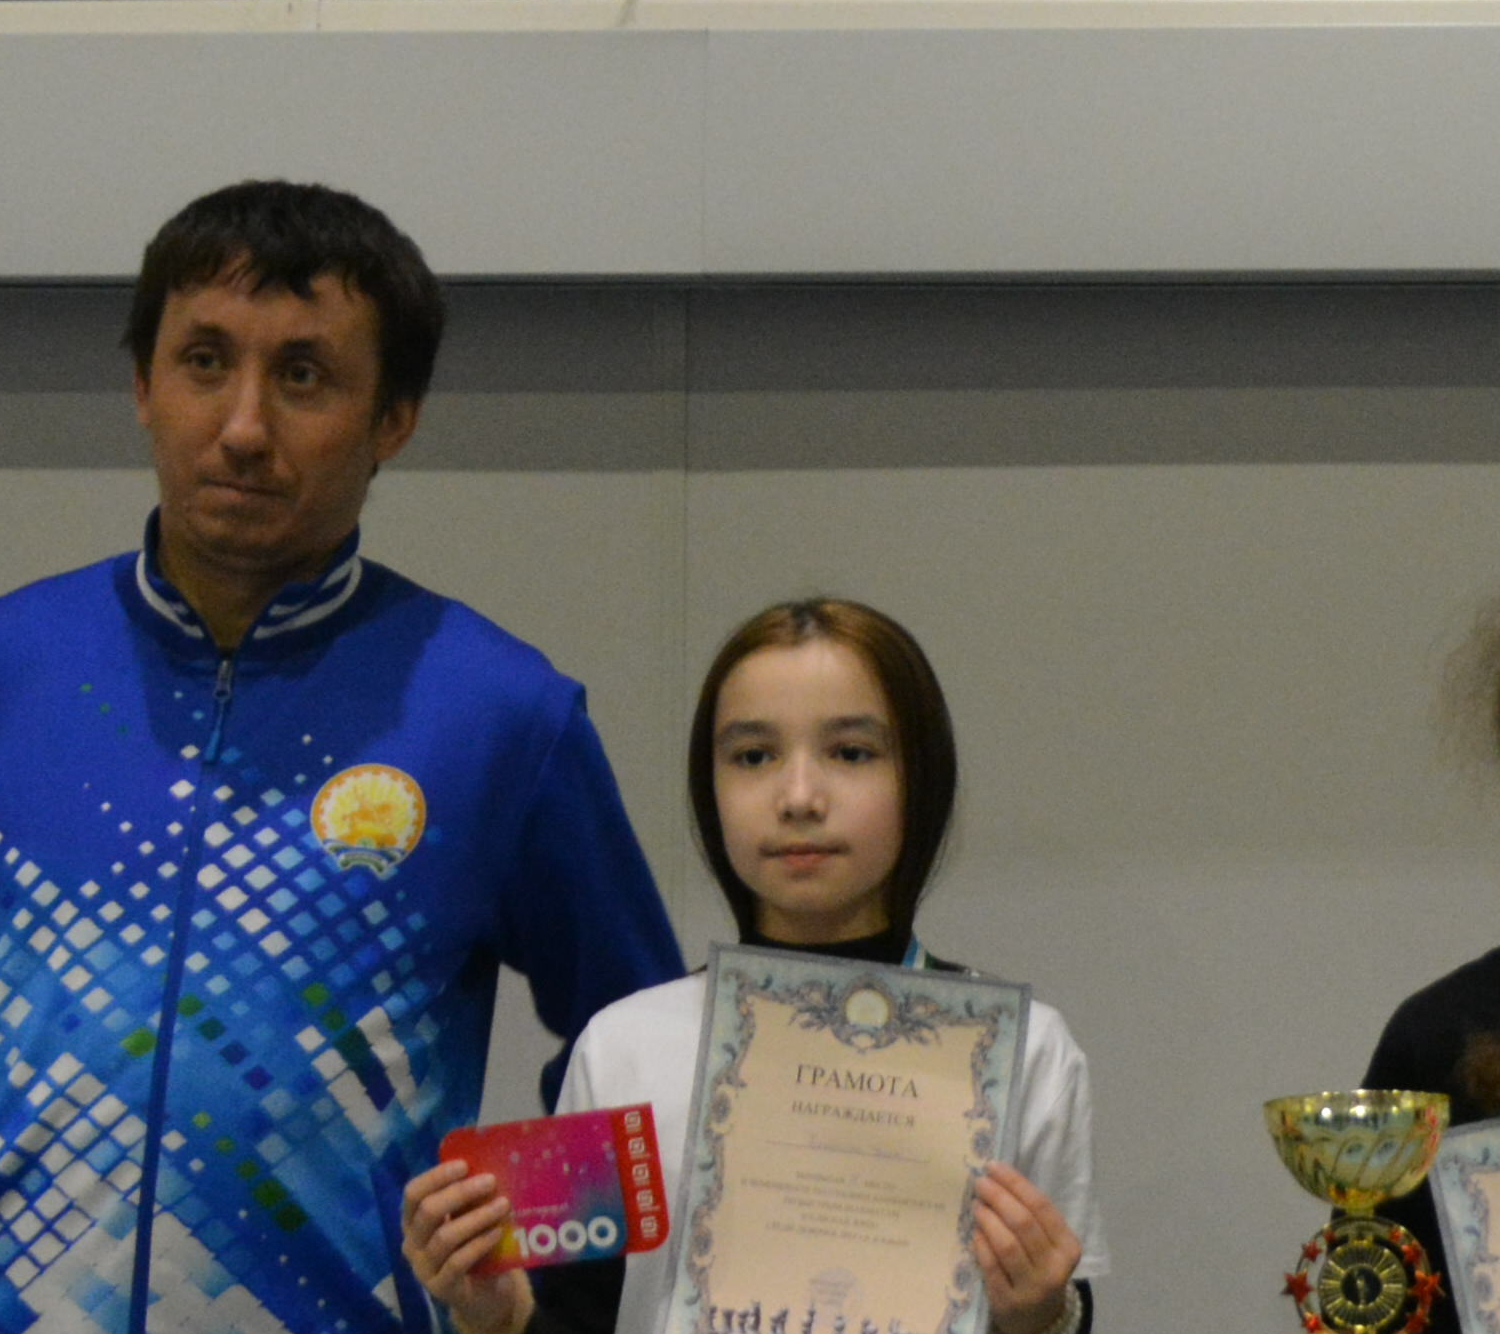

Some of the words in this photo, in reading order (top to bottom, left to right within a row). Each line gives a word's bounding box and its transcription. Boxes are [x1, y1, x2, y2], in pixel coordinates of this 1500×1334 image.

[796, 1064, 918, 1098] ГРАМОТА
[791, 1100, 915, 1128] НАГРАЖДАЕТСЯ
[513, 1215, 618, 1259] 1000
